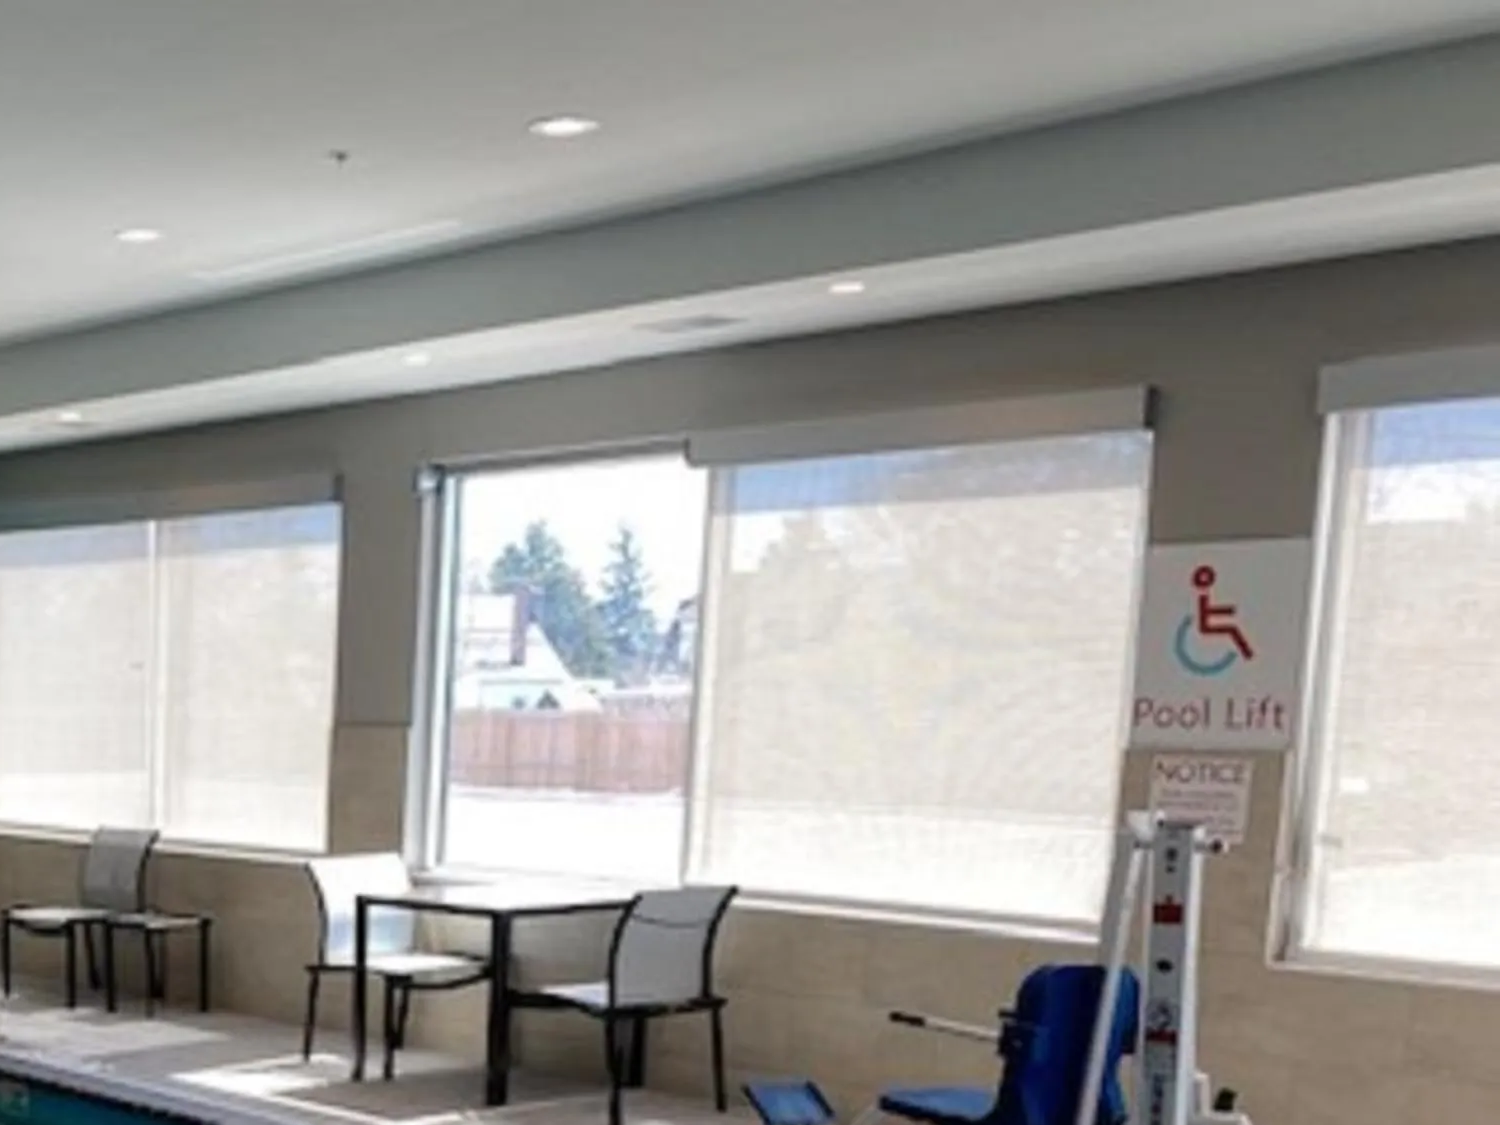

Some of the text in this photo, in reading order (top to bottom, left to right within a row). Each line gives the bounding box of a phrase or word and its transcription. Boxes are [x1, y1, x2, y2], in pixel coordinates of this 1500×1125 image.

[1133, 695, 1285, 730] Pool Lift
[1156, 760, 1244, 784] NOTICE
